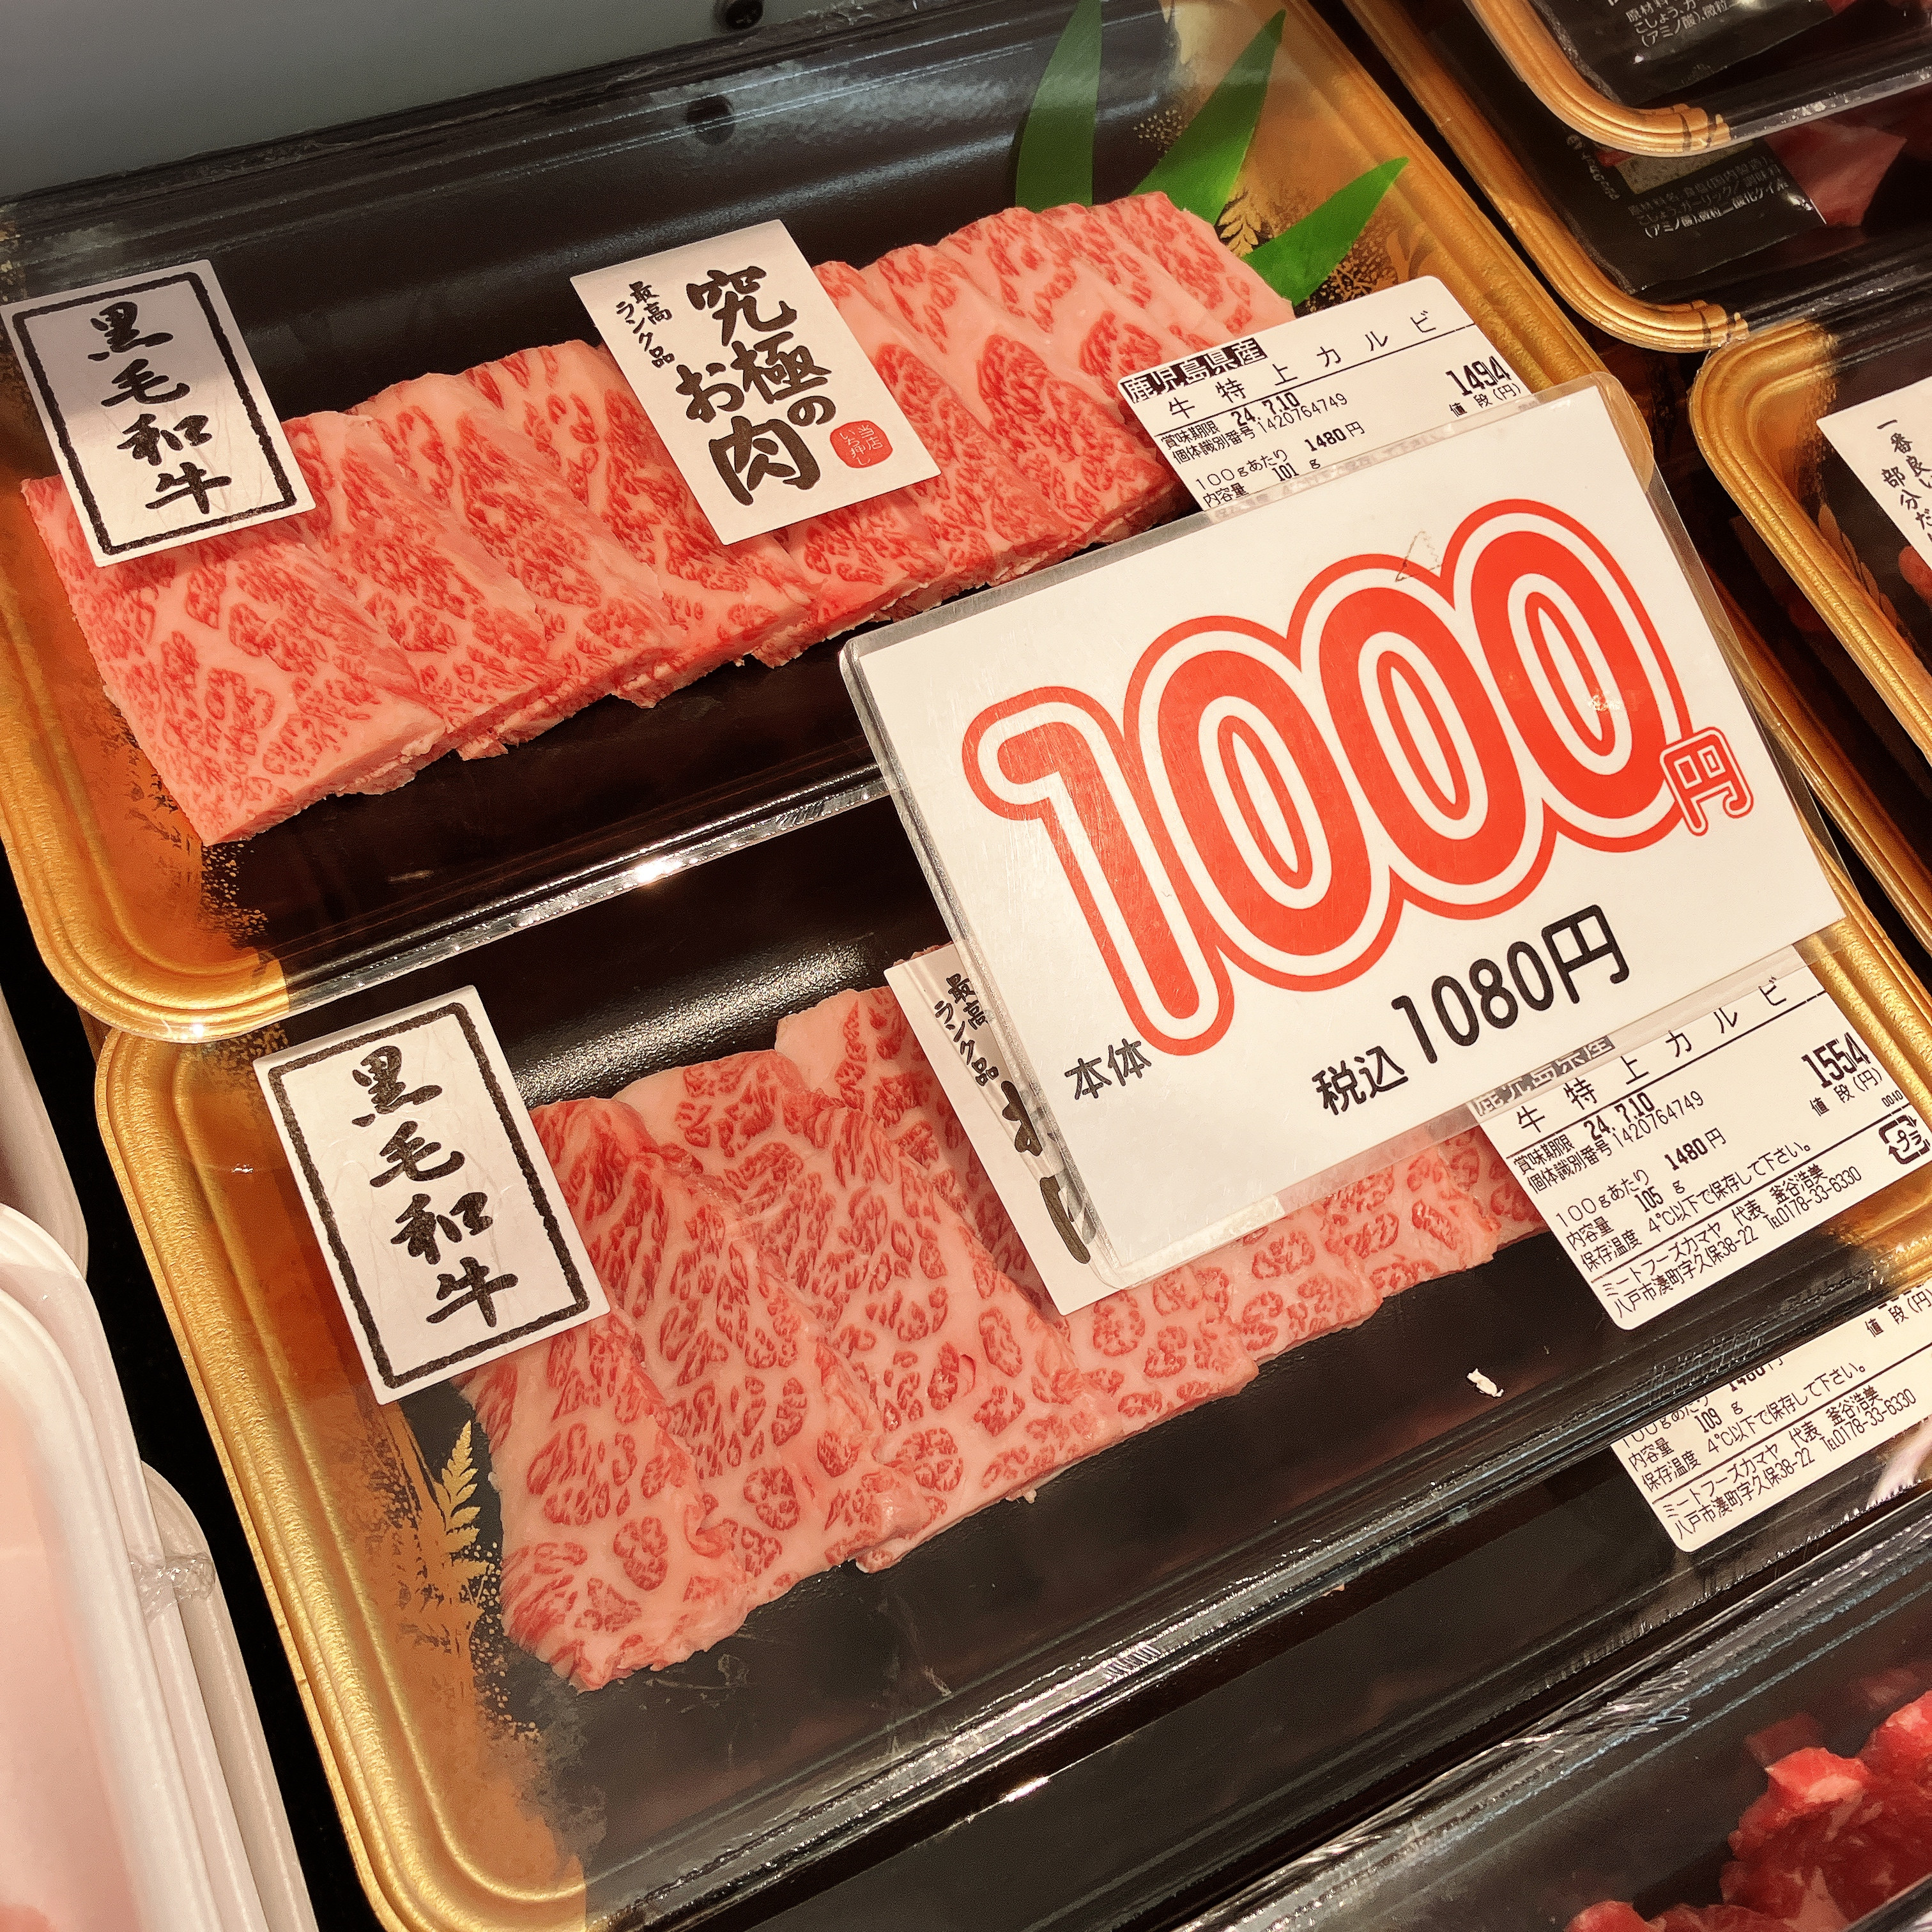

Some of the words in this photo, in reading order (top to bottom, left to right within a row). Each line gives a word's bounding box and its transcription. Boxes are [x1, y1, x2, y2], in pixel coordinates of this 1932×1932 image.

[616, 301, 675, 368] ランク品
[629, 280, 672, 325] 最高
[686, 266, 836, 425] 究極の
[1126, 337, 1268, 403] 鹿児島県産
[1446, 356, 1512, 397] 1494
[88, 301, 232, 514] 黒毛和牛
[676, 362, 820, 506] お肉
[1161, 420, 1221, 450] 賞味期限
[1172, 426, 1256, 465] 個体識別番号
[1257, 393, 1348, 434] 1420764749
[1196, 448, 1288, 490] 100gあたり
[1203, 484, 1250, 508] 内容量
[1272, 463, 1300, 481] 101
[1882, 466, 1932, 542] 部分だ
[1312, 1045, 1407, 1116] 税込
[1392, 903, 1632, 1066] 1080円
[934, 1000, 999, 1086] ランク品
[1064, 1038, 1151, 1100] 本体
[1802, 1032, 1871, 1089] 1554
[1514, 1134, 1575, 1175] 賞味期限
[1527, 1138, 1613, 1194] 個体識別番号
[1613, 1091, 1704, 1147] 1420764749
[351, 1045, 519, 1328] 黒毛和牛
[1556, 1169, 1650, 1228] 100gあたり
[1567, 1216, 1614, 1251] 内容量
[1634, 1186, 1664, 1213] 105
[1580, 1230, 1643, 1272] 保存温度
[1602, 1222, 1721, 1297] ミートフーズカマヤ
[1733, 1199, 1766, 1227] 代表
[1629, 1437, 1675, 1471] 内容量
[1694, 1407, 1722, 1434] 109
[1641, 1450, 1701, 1492] 保存温度
[1662, 1443, 1778, 1518] ミートフーズカマヤ
[1788, 1420, 1822, 1449] 代表
